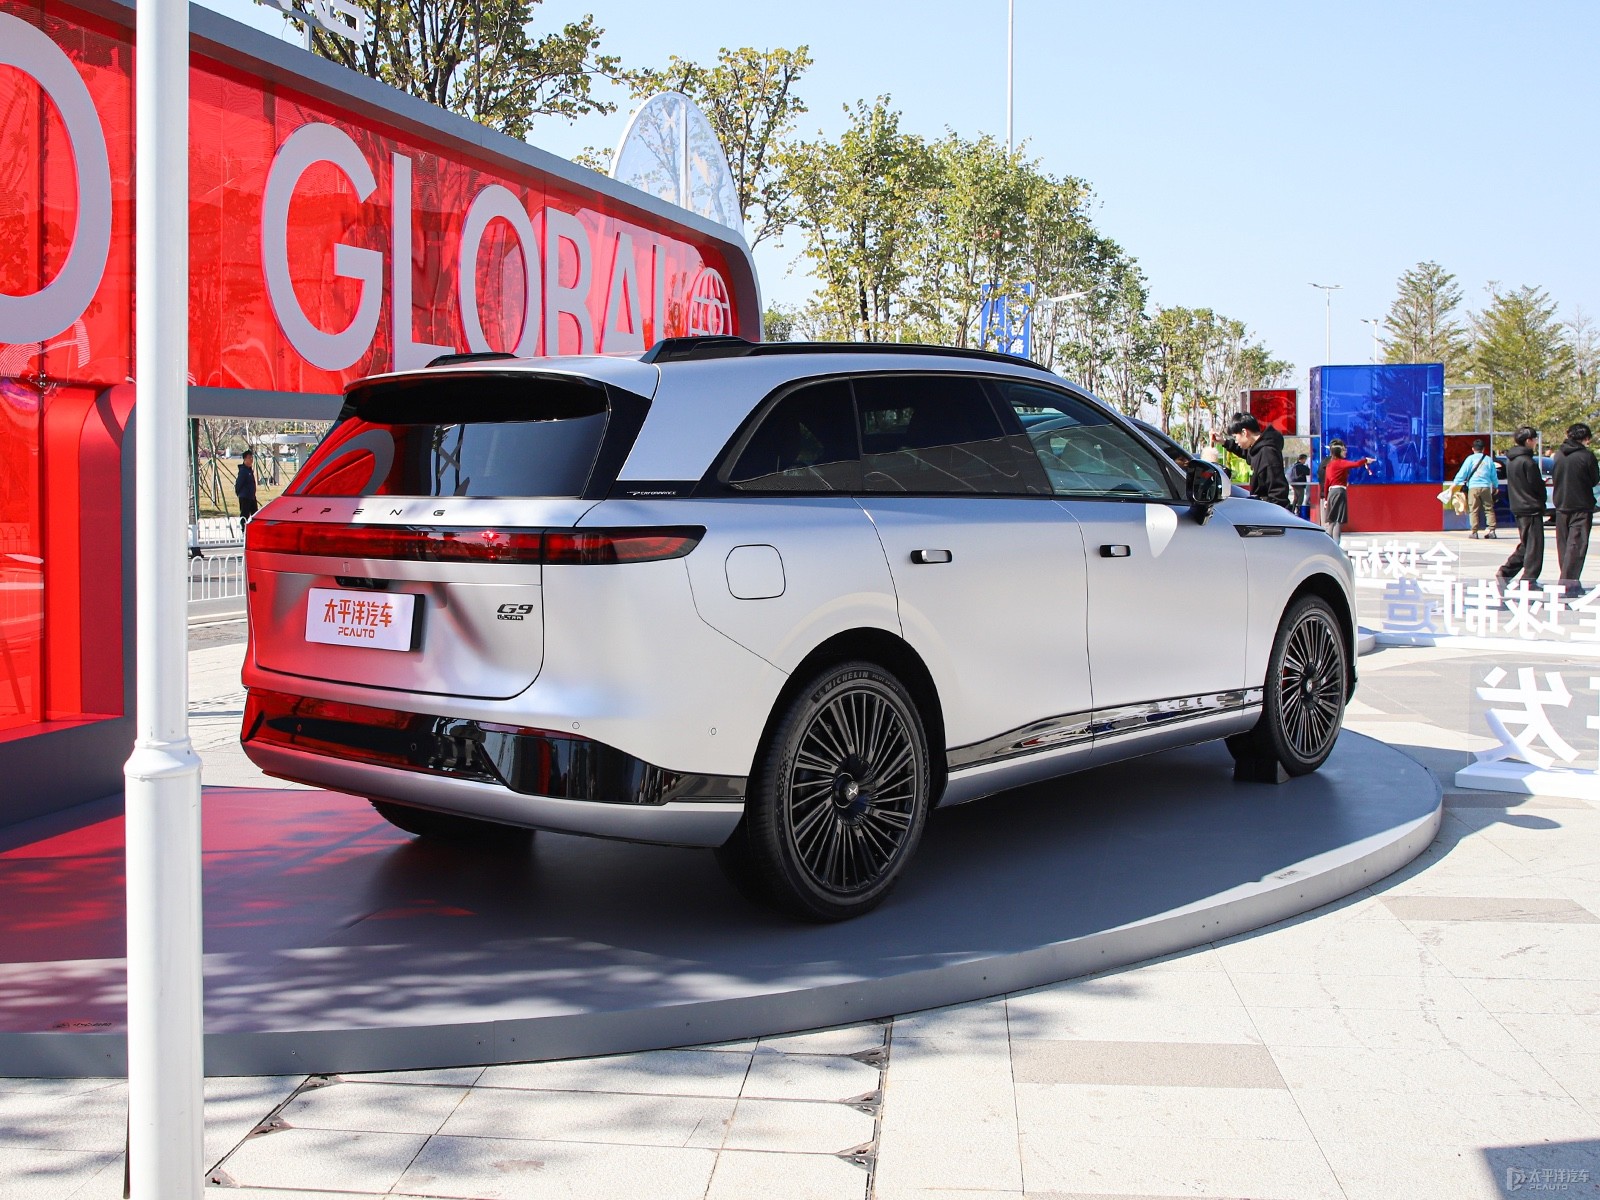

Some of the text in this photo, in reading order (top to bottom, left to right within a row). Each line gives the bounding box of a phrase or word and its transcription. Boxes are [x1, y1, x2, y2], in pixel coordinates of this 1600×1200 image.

[323, 598, 393, 628] 太平洋汽车
[496, 603, 534, 614] G9
[338, 626, 375, 639] PCAUTO
[825, 671, 869, 692] MICHELIN
